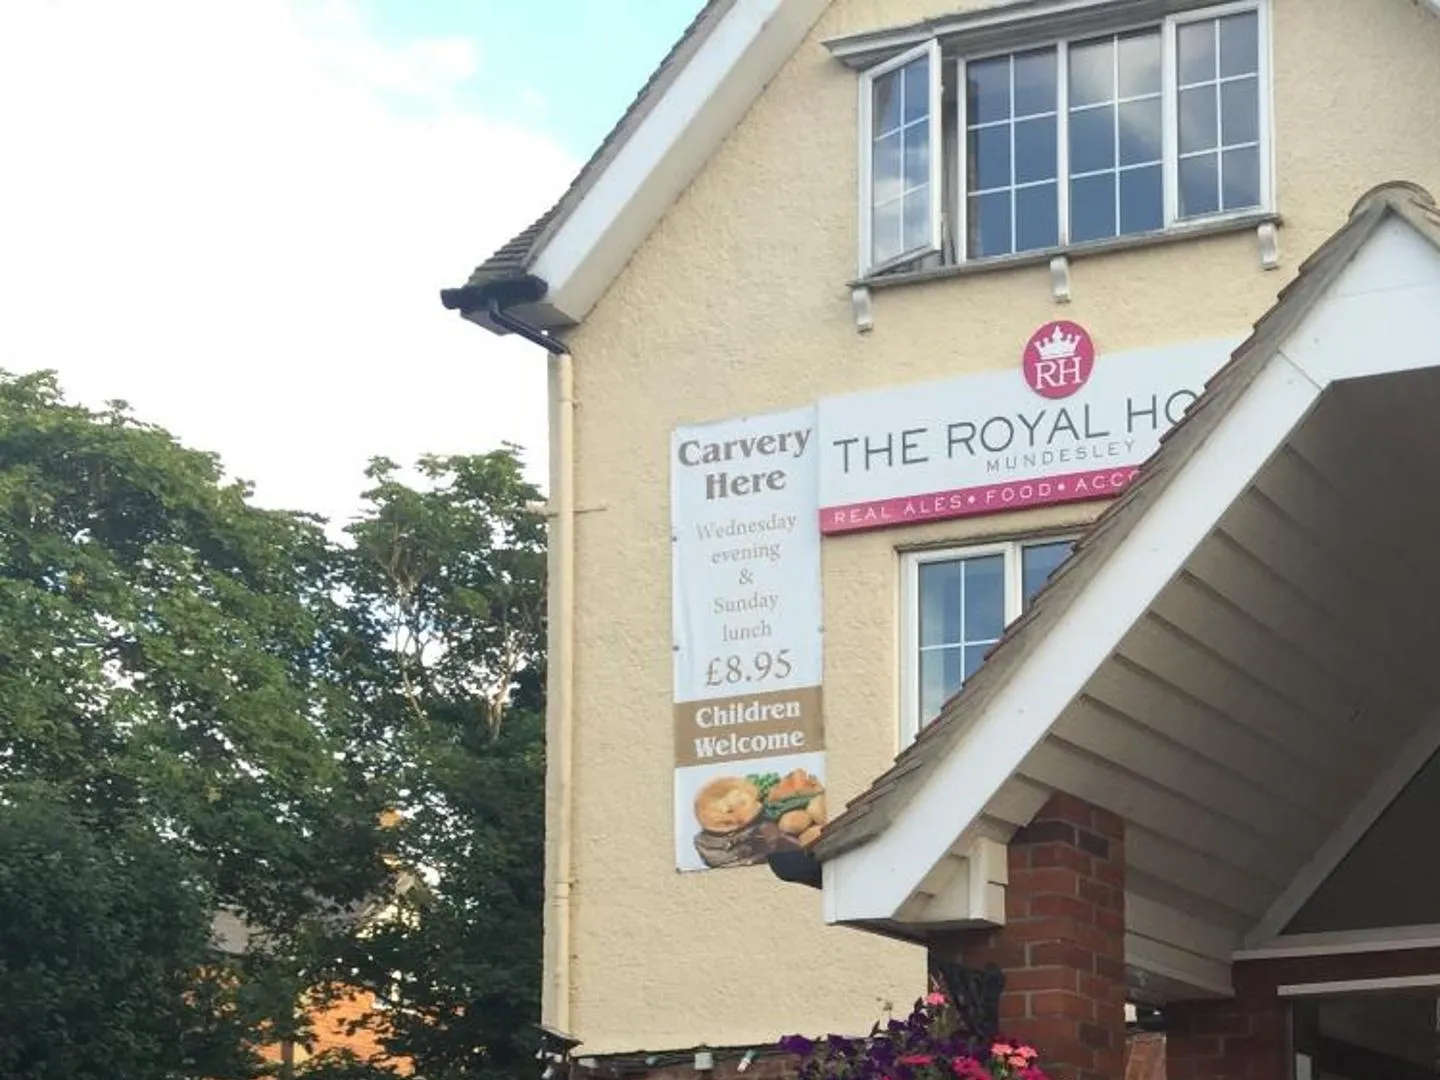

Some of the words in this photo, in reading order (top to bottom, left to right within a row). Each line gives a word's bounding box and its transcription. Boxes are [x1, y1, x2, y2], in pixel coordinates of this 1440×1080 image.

[1034, 357, 1083, 389] RH
[678, 427, 812, 467] Carvery
[833, 428, 929, 474] THE
[947, 403, 1110, 459] ROYAL
[986, 439, 1136, 474] MUNDESLEY
[706, 469, 787, 500] Here
[834, 505, 892, 525] REAL
[903, 493, 962, 519] ALES
[985, 482, 1053, 505] FOOD
[695, 513, 797, 540] Wednesday
[711, 543, 781, 566] evening
[738, 568, 753, 585] &
[712, 591, 779, 614] Sunday
[722, 619, 772, 642] lunch
[705, 648, 793, 687] £8.95
[695, 700, 800, 728] Children
[693, 730, 805, 758] Welcome
